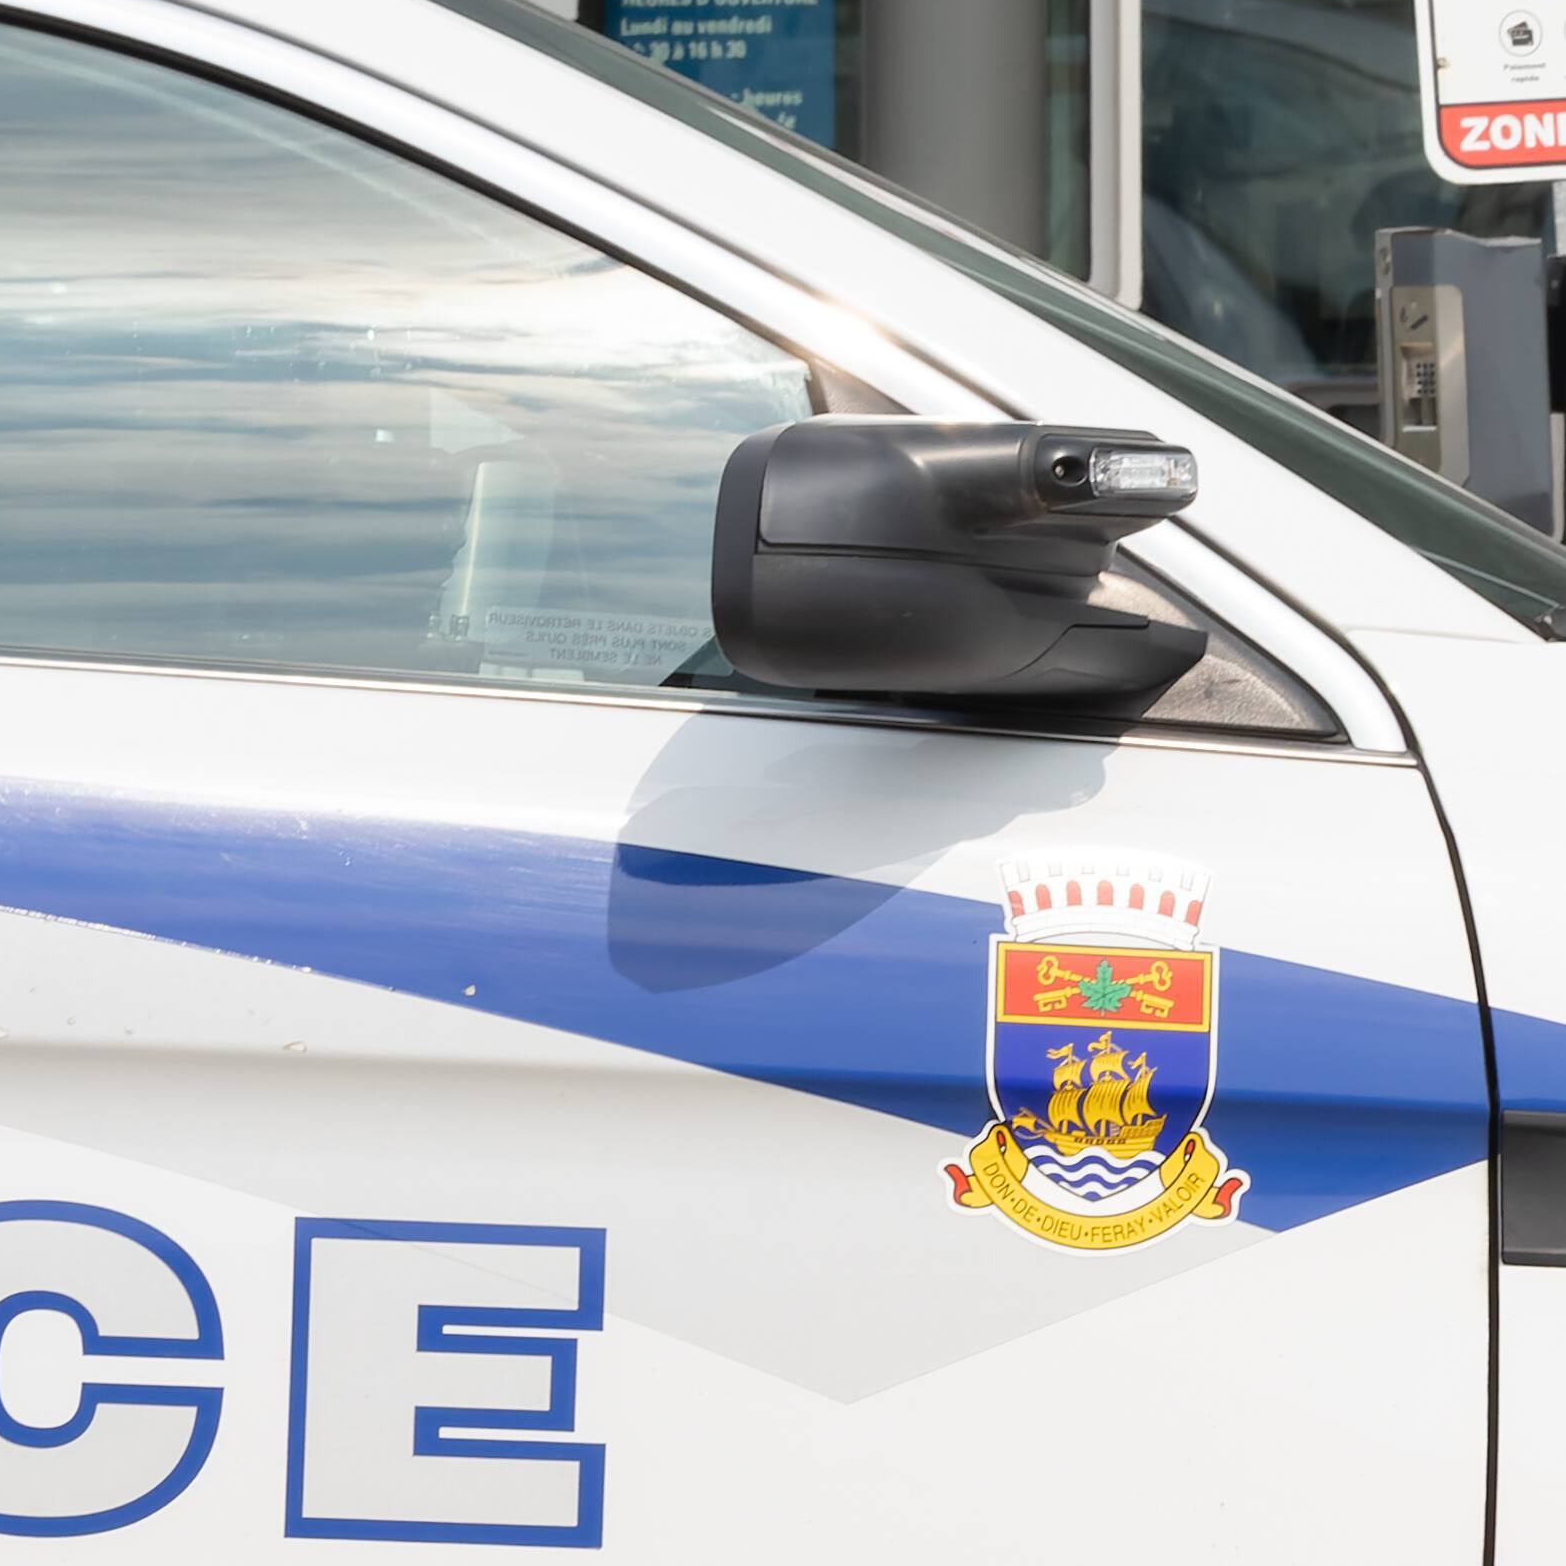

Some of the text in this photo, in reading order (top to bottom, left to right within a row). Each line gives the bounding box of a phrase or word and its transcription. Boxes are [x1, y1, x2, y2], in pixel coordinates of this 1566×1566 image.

[620, 14, 773, 36] Lundi au vendredi
[983, 1161, 1207, 1244] DON DE DIEU FERAY VALOIR
